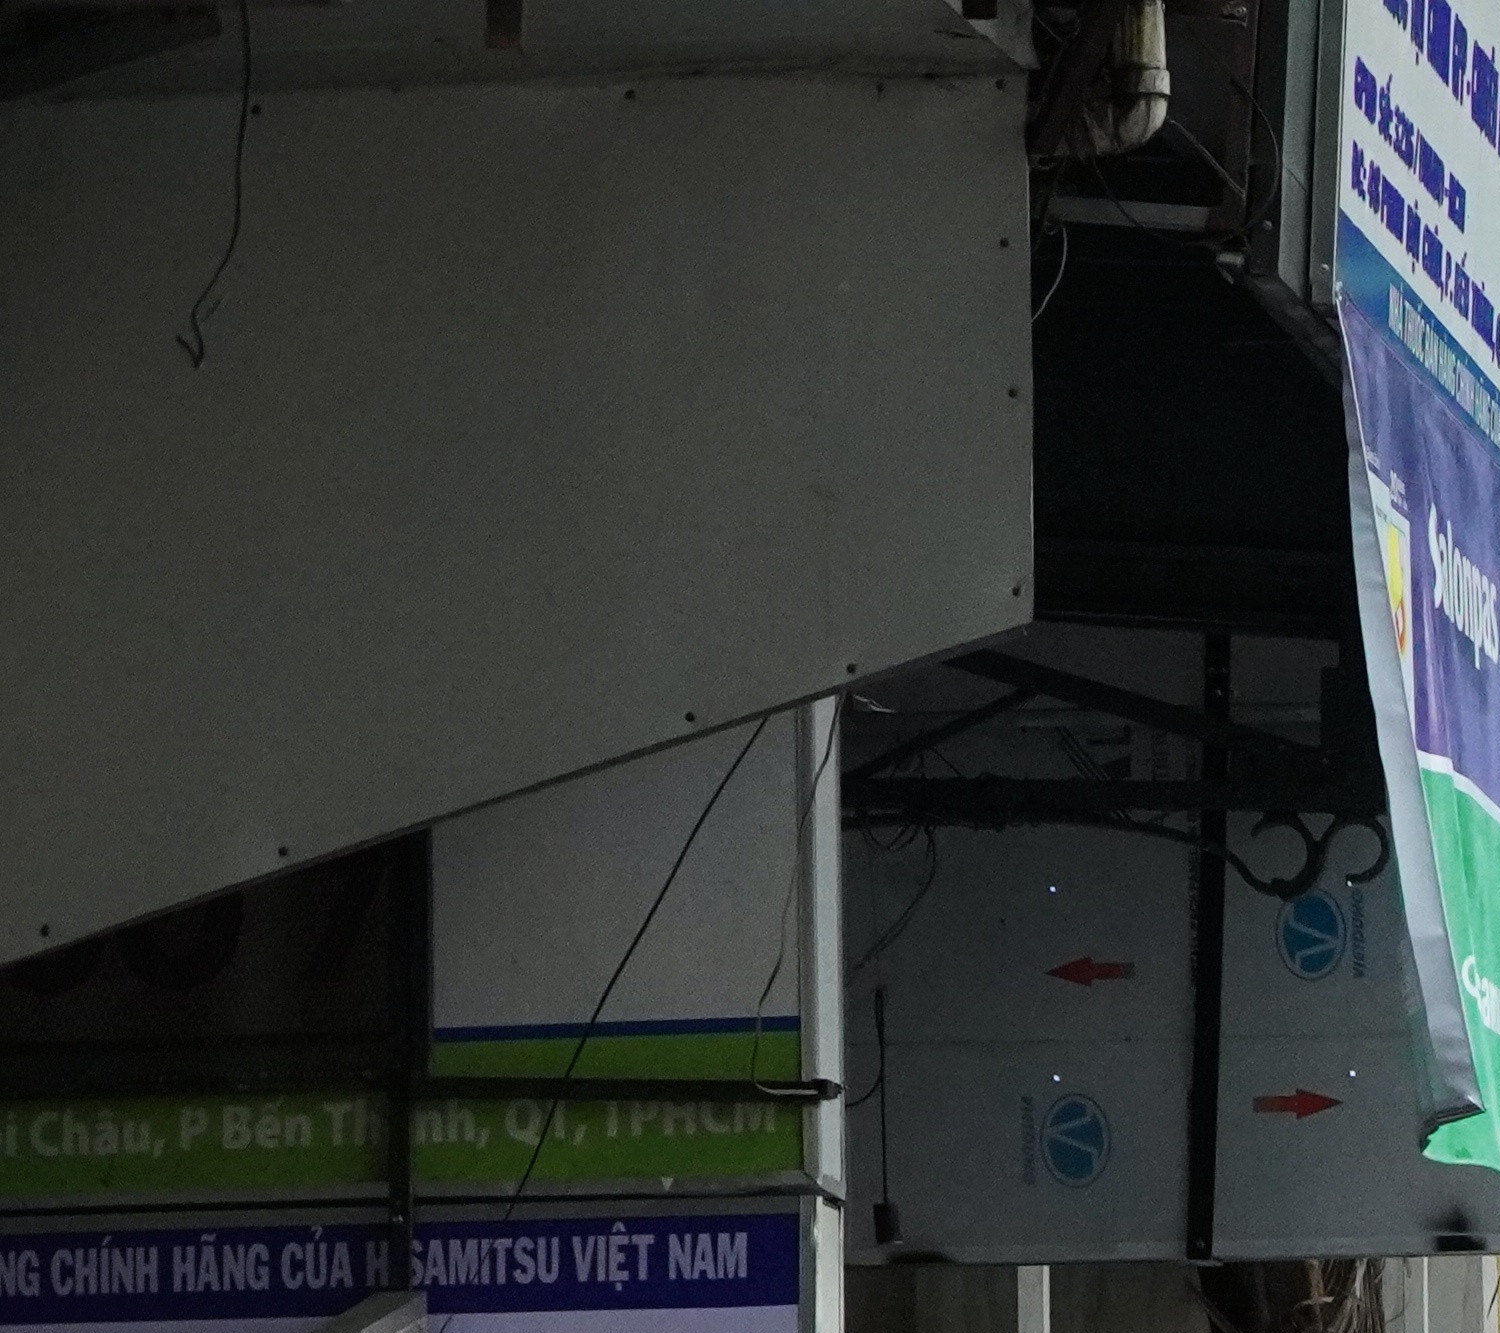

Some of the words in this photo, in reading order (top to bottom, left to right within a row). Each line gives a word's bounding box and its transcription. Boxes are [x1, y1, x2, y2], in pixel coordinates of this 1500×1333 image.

[322, 1095, 490, 1149] Thnh,
[51, 1236, 158, 1296] CHÍNH
[173, 1233, 271, 1293] HÃNG
[281, 1225, 354, 1290] CỦA
[366, 1234, 560, 1288] HSAMITSU
[572, 1220, 655, 1291] VIỆT
[669, 1232, 748, 1280] NAM
